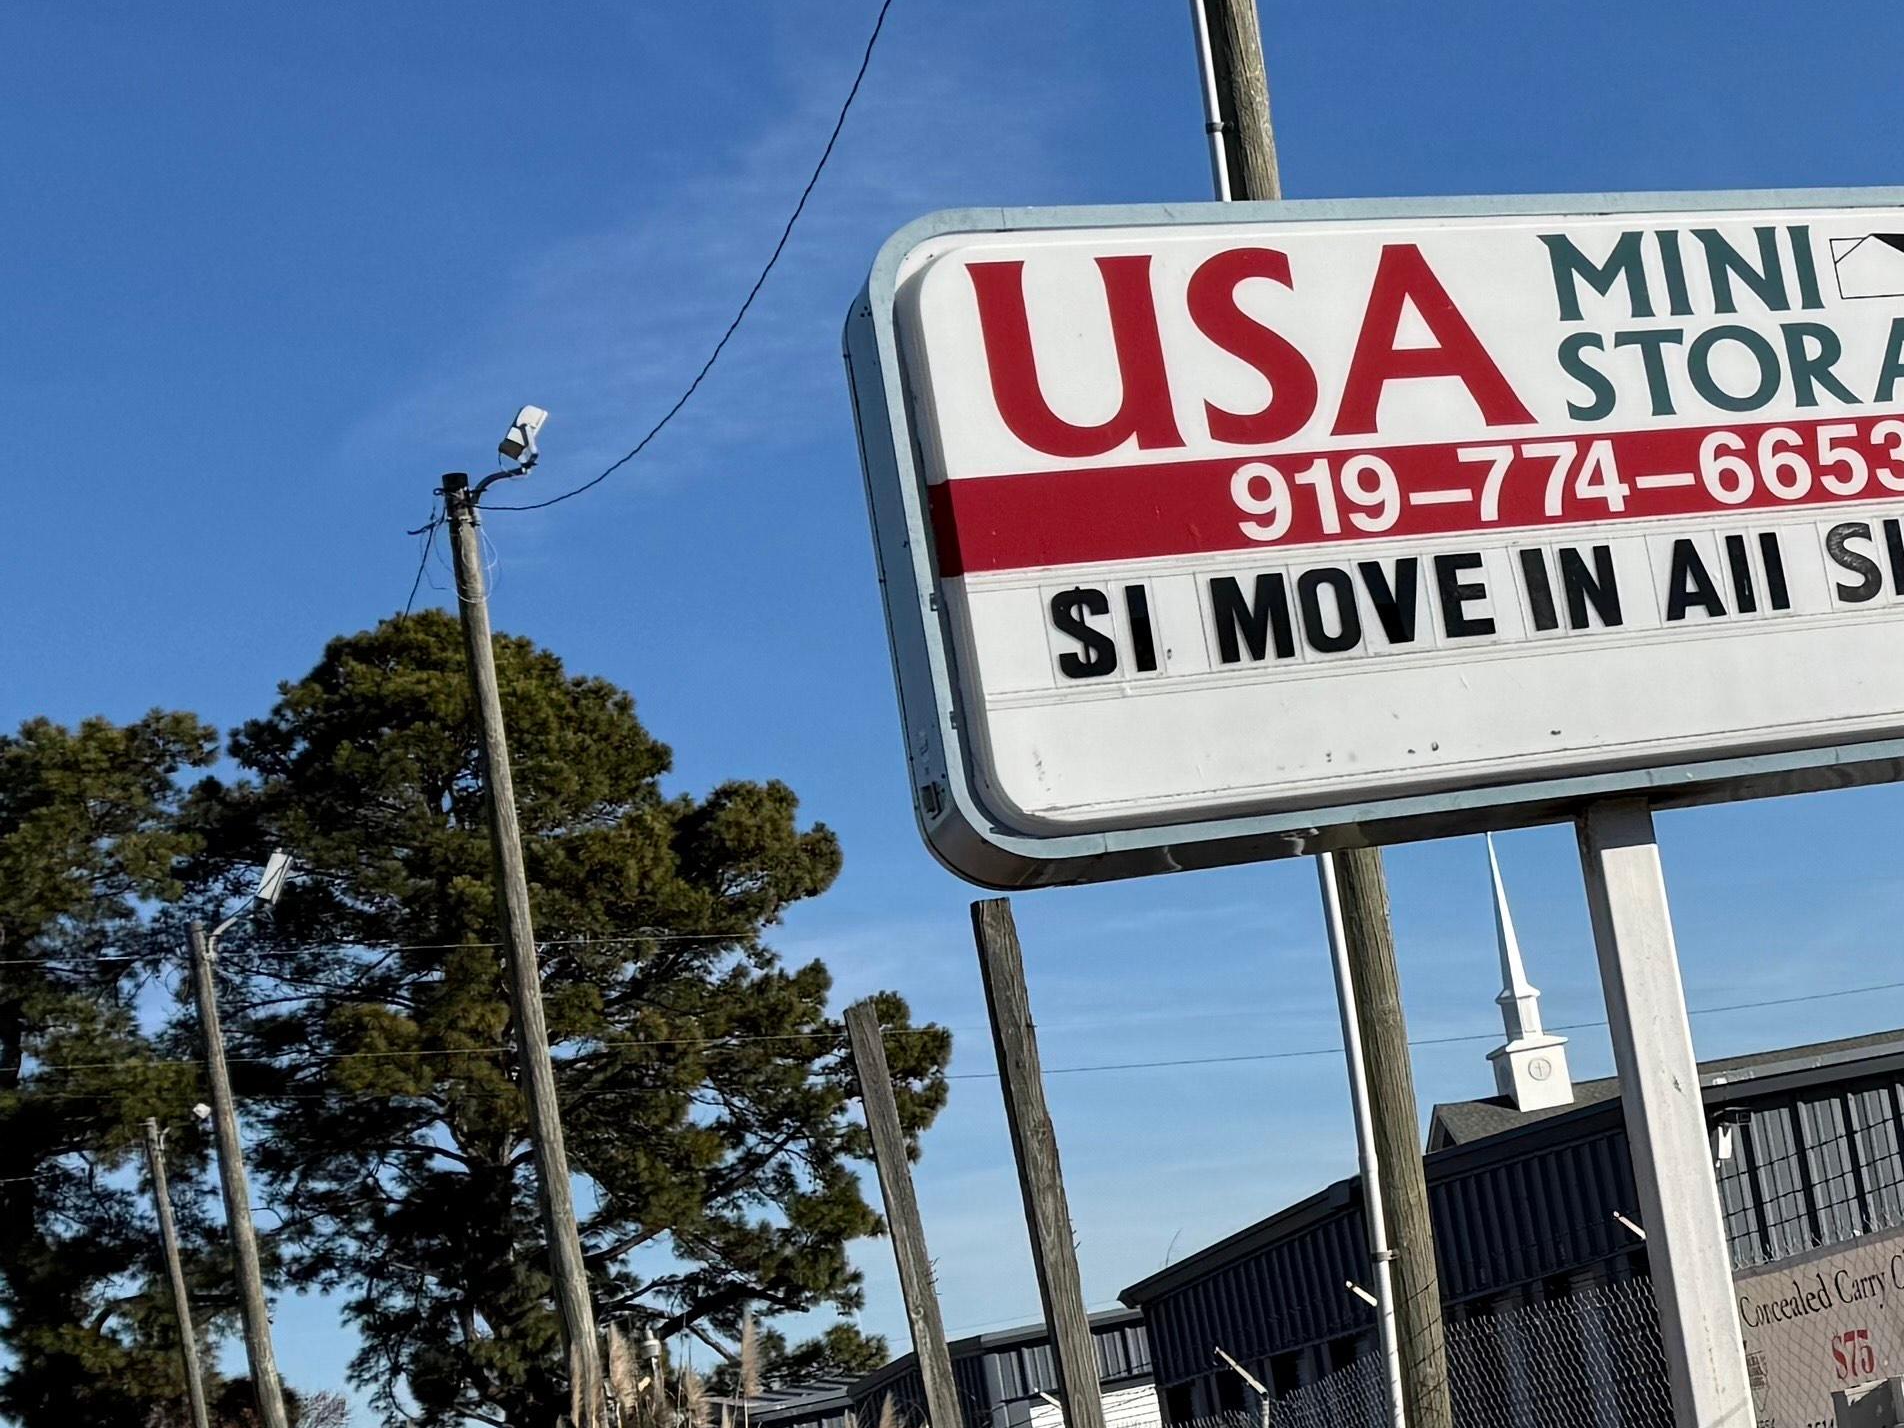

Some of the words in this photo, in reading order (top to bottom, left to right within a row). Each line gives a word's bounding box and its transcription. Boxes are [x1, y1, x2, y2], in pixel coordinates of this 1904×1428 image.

[1536, 225, 1825, 321] MINI
[964, 243, 1539, 458] USA
[1209, 552, 1496, 664] MOVE
[1520, 545, 1623, 632] IN
[1739, 1272, 1833, 1328] Concealed
[1834, 1269, 1886, 1309] Carry
[1831, 1328, 1875, 1380] $75
